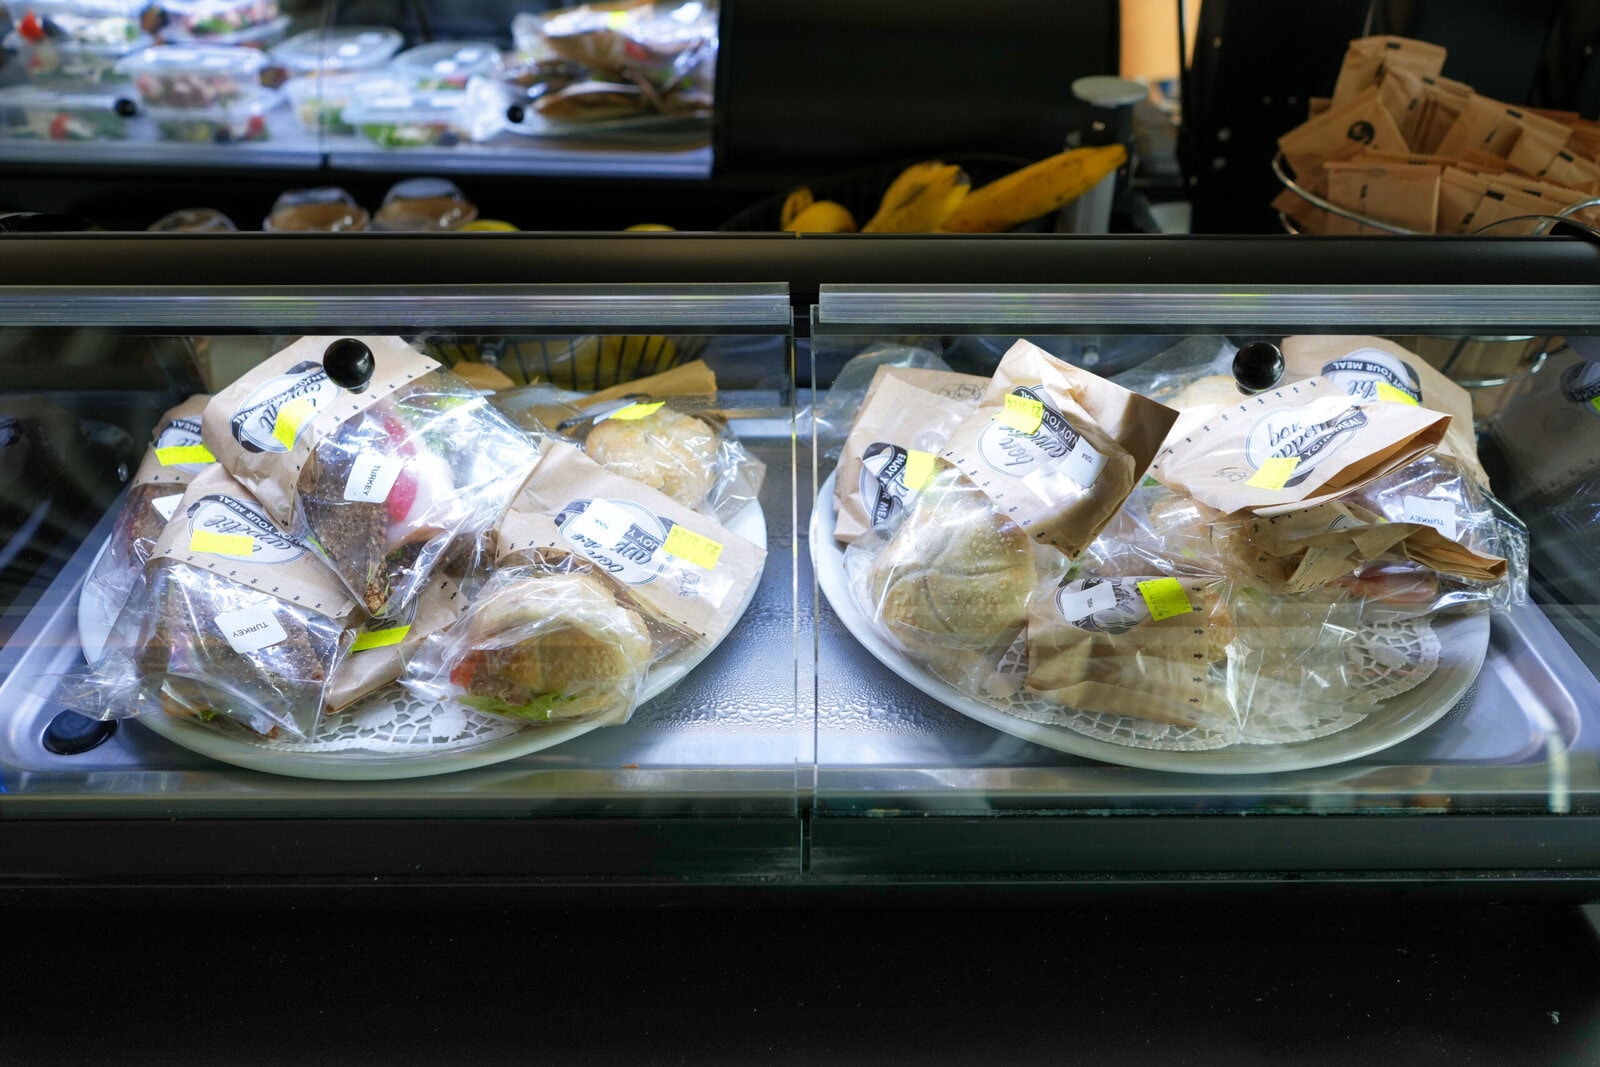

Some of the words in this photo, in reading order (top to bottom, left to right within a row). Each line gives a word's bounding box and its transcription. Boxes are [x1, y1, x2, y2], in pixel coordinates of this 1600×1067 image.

[1332, 361, 1363, 371] MEAL
[1365, 363, 1394, 380] YOUR
[172, 420, 201, 433] MEAL
[884, 452, 907, 478] ENJOY
[362, 464, 382, 497] TURKEY
[218, 493, 247, 514] MEAL
[245, 509, 275, 534] YOUR
[1409, 514, 1445, 526] TURKEY
[232, 621, 269, 638] TURKEY
